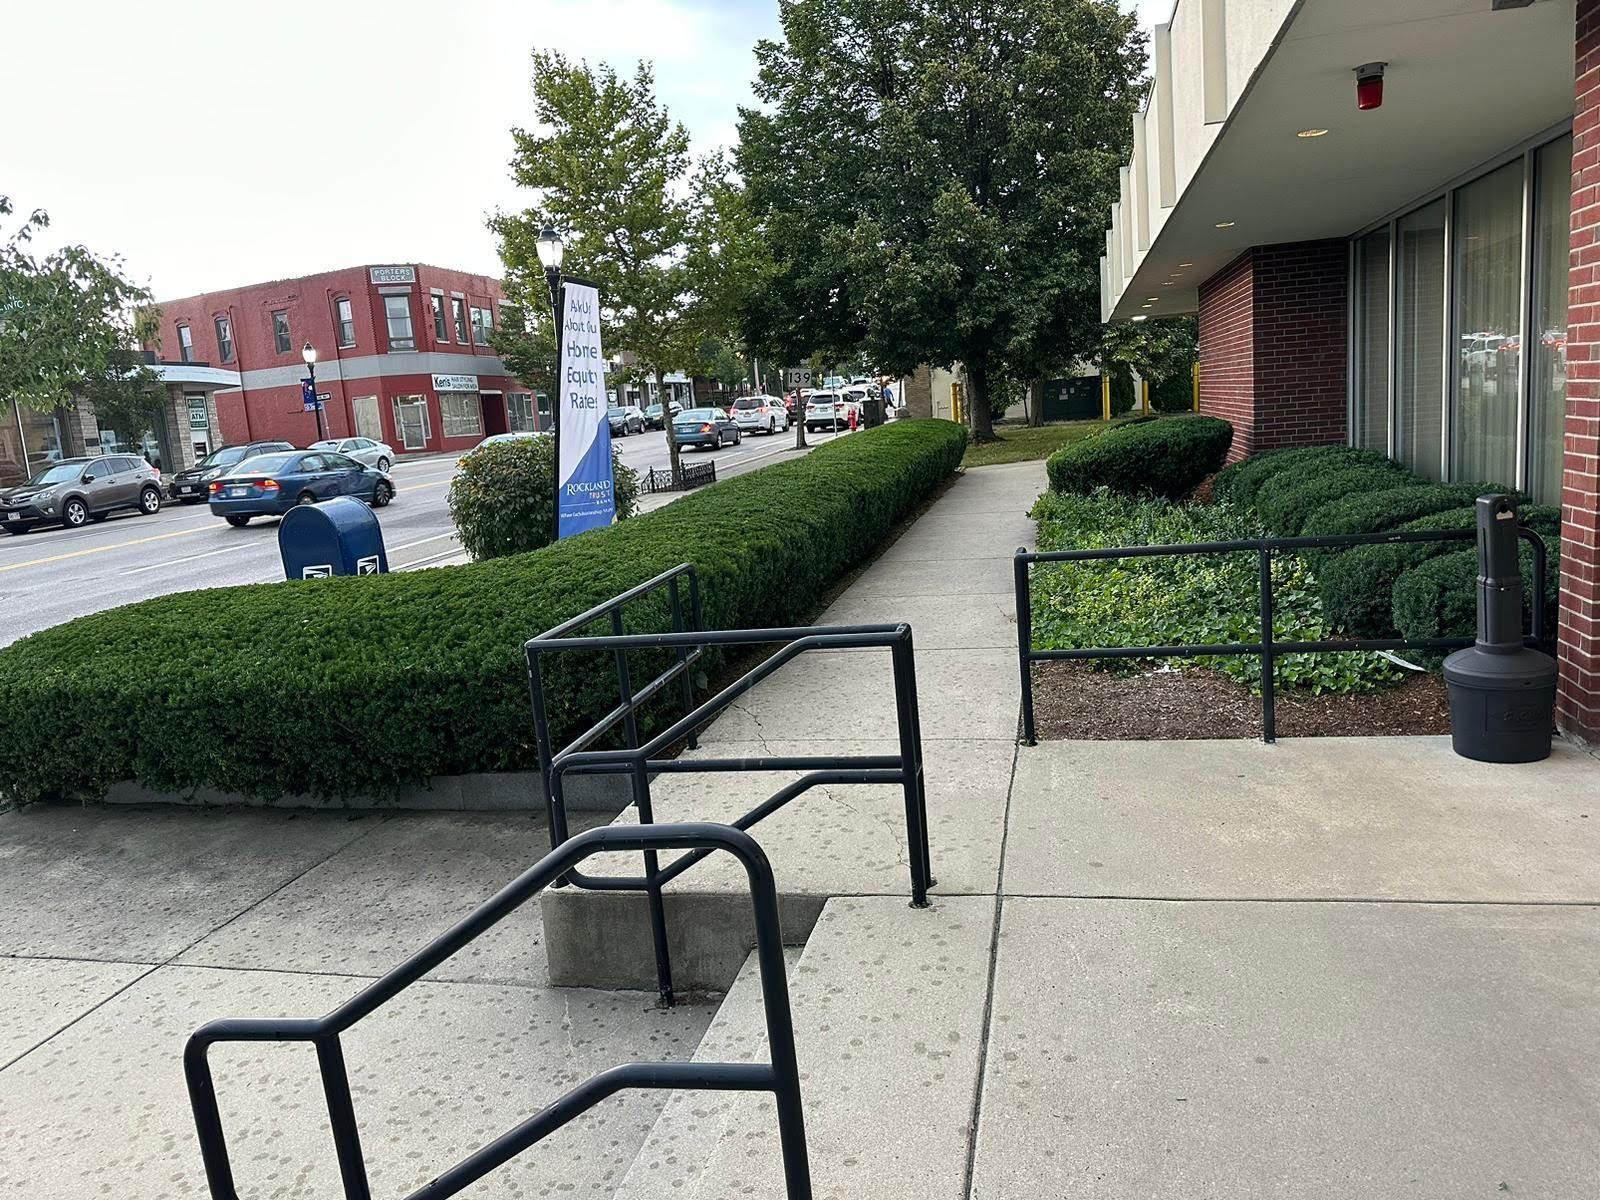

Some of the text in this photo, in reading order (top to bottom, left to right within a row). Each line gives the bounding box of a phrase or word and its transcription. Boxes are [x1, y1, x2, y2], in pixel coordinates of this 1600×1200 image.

[587, 320, 597, 333] Ou
[567, 340, 597, 359] Home
[567, 366, 597, 389] Equty
[789, 372, 811, 384] 139
[570, 392, 598, 409] Rates
[567, 480, 611, 495] ROCKLAND
[589, 490, 610, 499] TRUST
